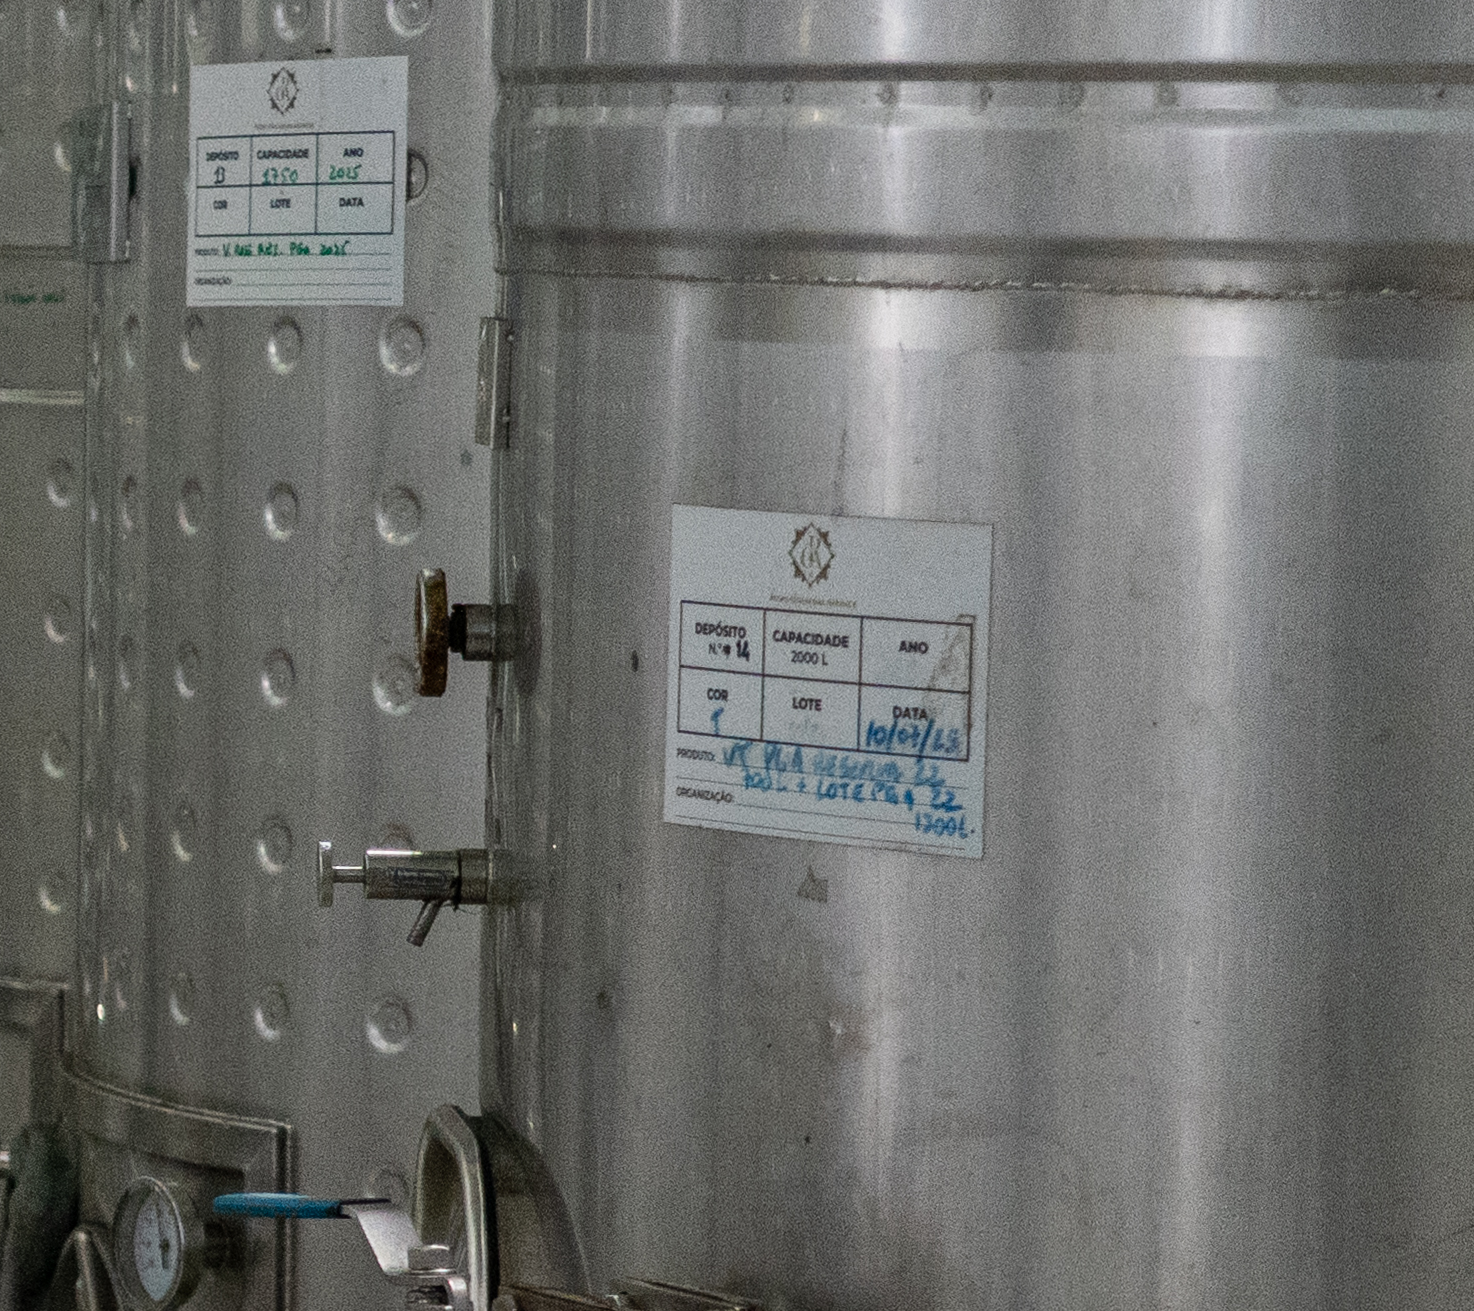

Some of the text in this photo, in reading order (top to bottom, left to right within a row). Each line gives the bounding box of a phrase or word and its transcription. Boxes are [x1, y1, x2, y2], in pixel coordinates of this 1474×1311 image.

[257, 149, 309, 160] CAPACIDADE
[343, 147, 364, 157] ANO
[270, 198, 291, 209] LOTE
[339, 197, 364, 207] DATA
[695, 621, 746, 639] DEPÓSITO
[773, 630, 849, 648] CAPACIDADE
[898, 640, 929, 654] ANO
[707, 688, 729, 701] COR
[792, 697, 822, 711] LOTE
[892, 706, 928, 721] DATA
[816, 780, 864, 803] LOTE
